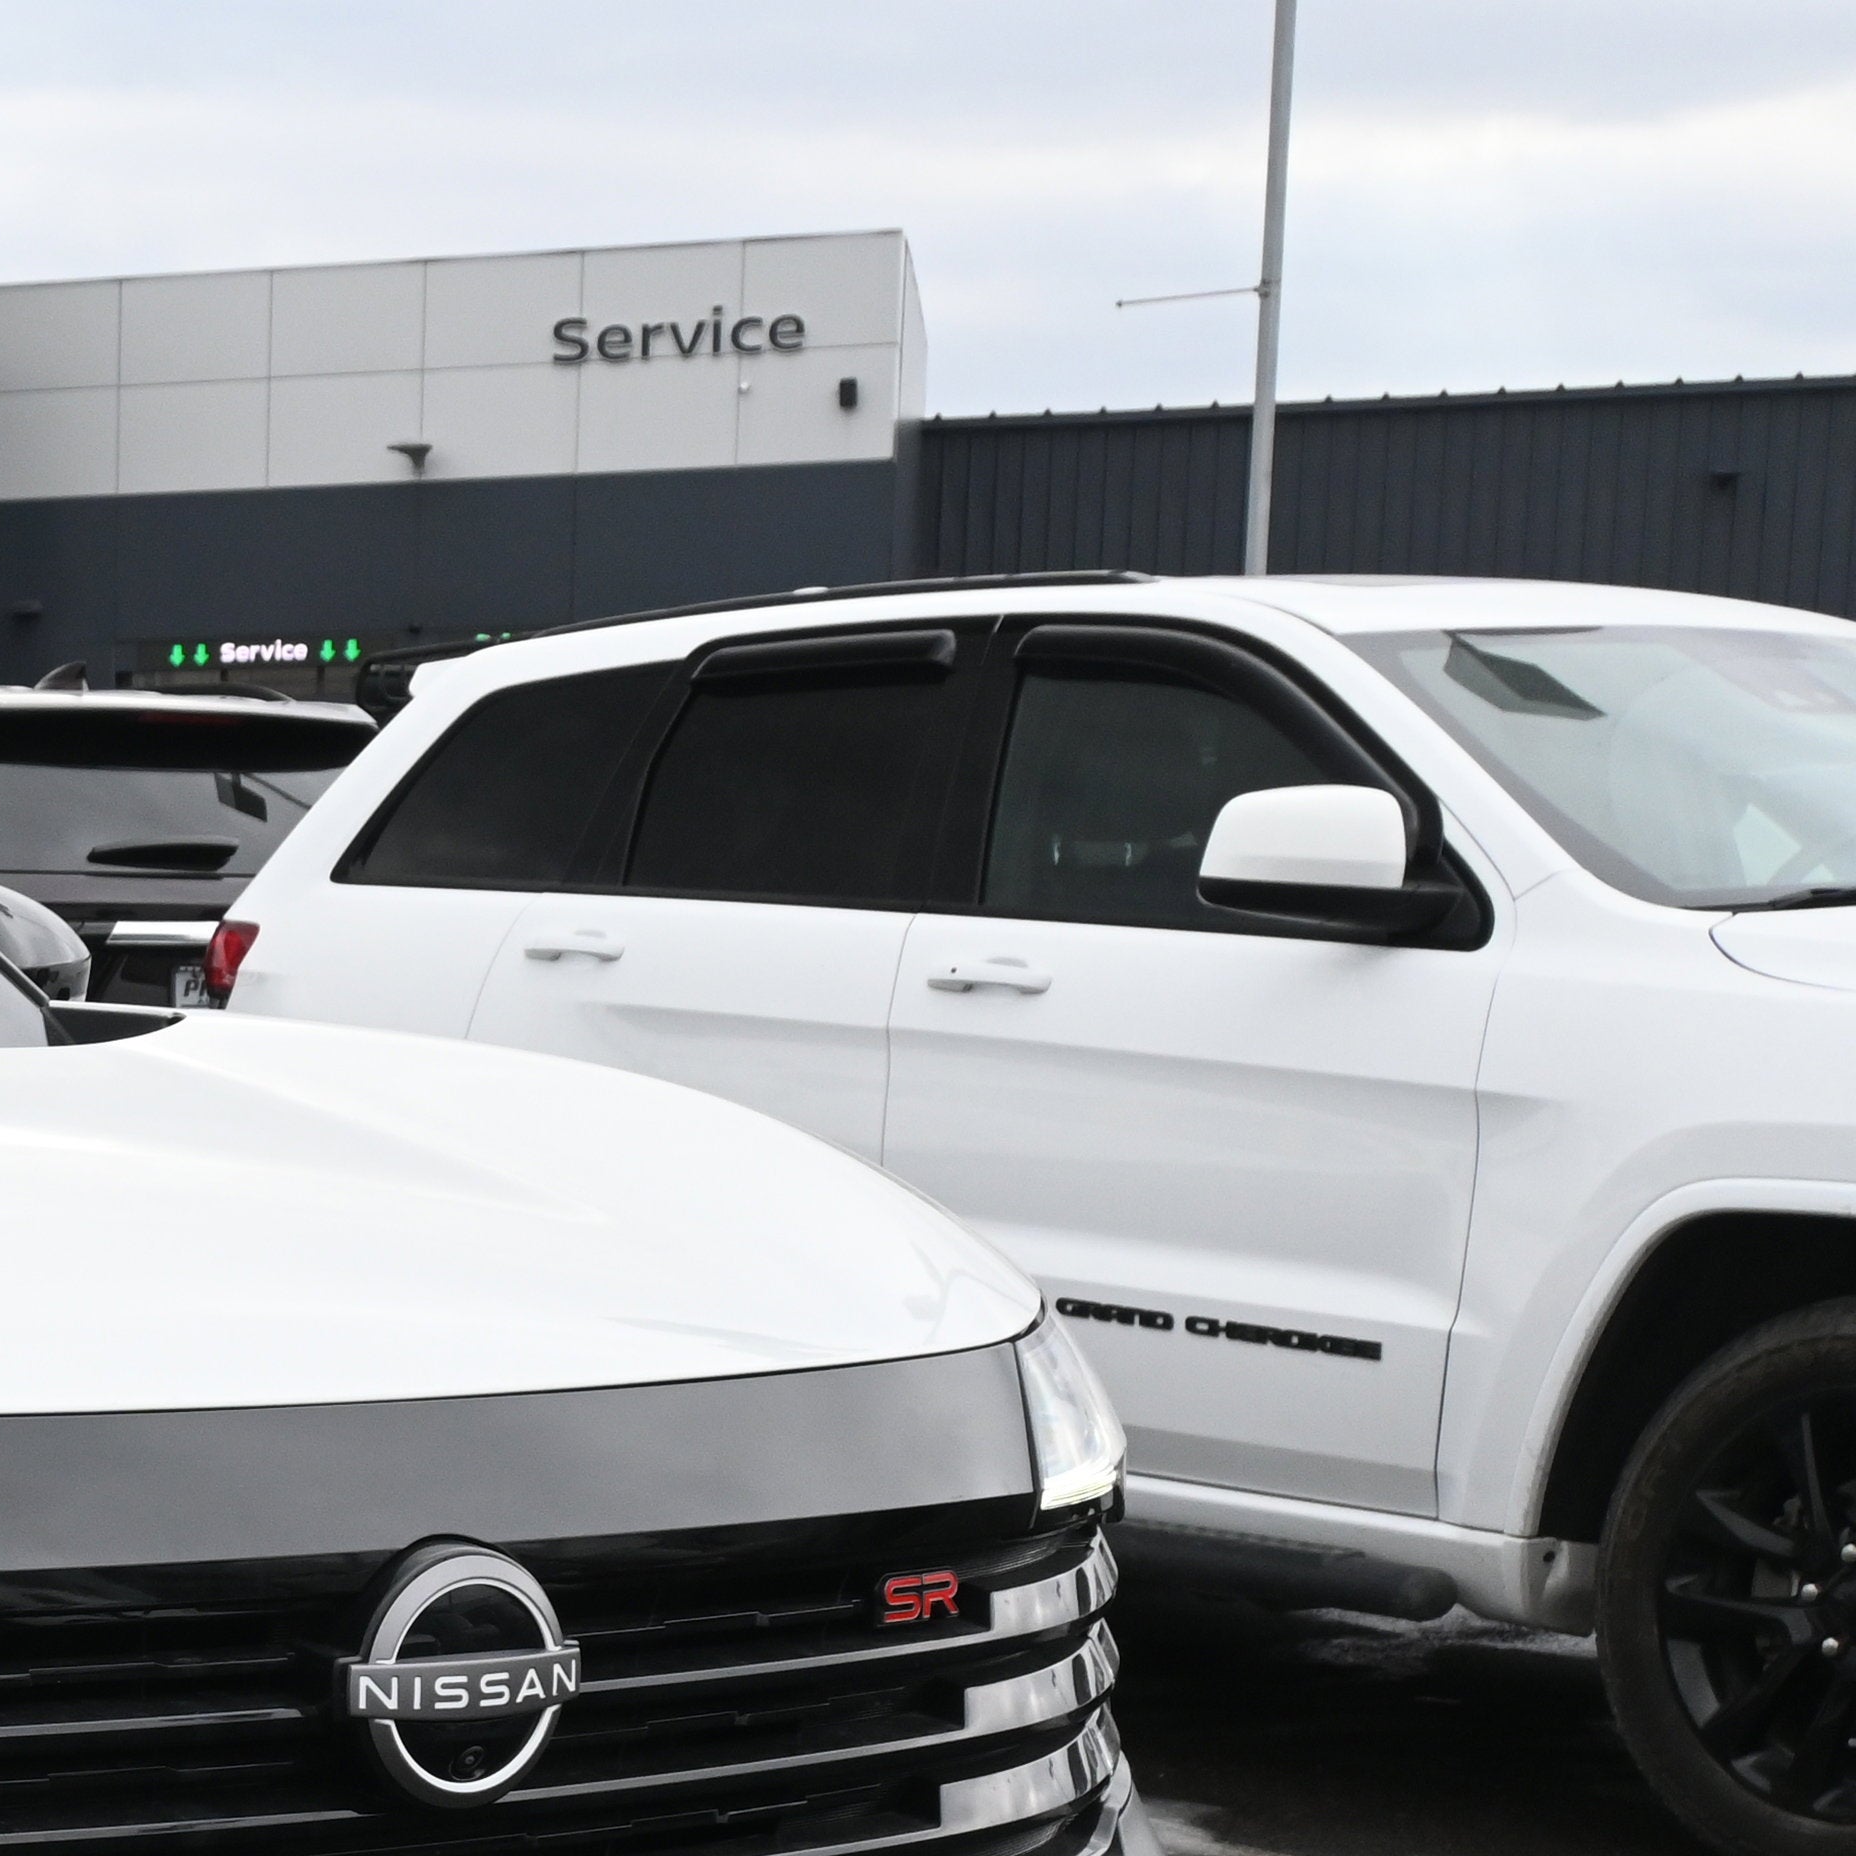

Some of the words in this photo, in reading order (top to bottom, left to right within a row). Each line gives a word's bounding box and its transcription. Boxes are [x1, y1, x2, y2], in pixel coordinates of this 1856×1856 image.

[552, 304, 807, 364] Service
[219, 638, 309, 663] Service
[883, 1569, 960, 1623] SR
[358, 1658, 577, 1711] NISSAN
